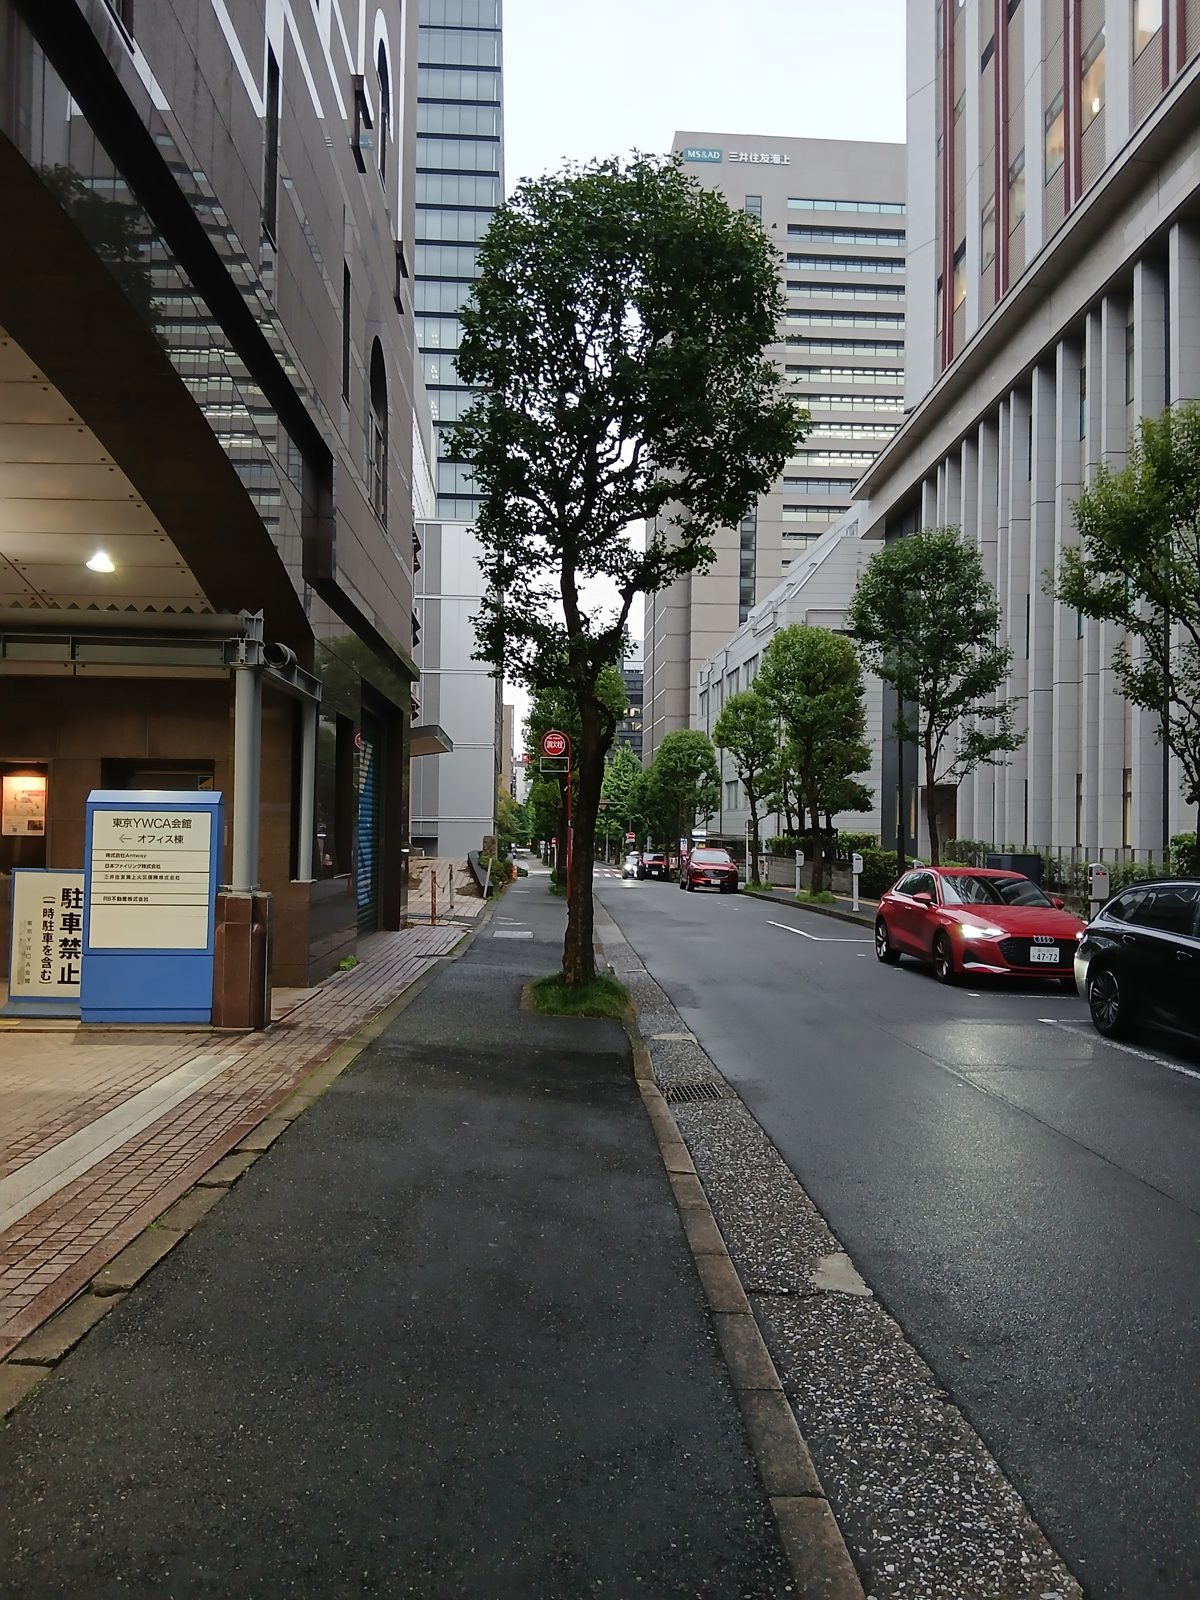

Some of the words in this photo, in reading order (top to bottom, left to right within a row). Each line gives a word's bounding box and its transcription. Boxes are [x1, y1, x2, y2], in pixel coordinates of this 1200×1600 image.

[687, 150, 720, 159] MS&AD
[729, 151, 791, 165] 三井住友海上
[112, 818, 192, 829] 東京YWCA会館
[137, 834, 184, 844] オフィス棟
[57, 887, 84, 985] 駐車禁止
[1036, 953, 1058, 962] 47-72
